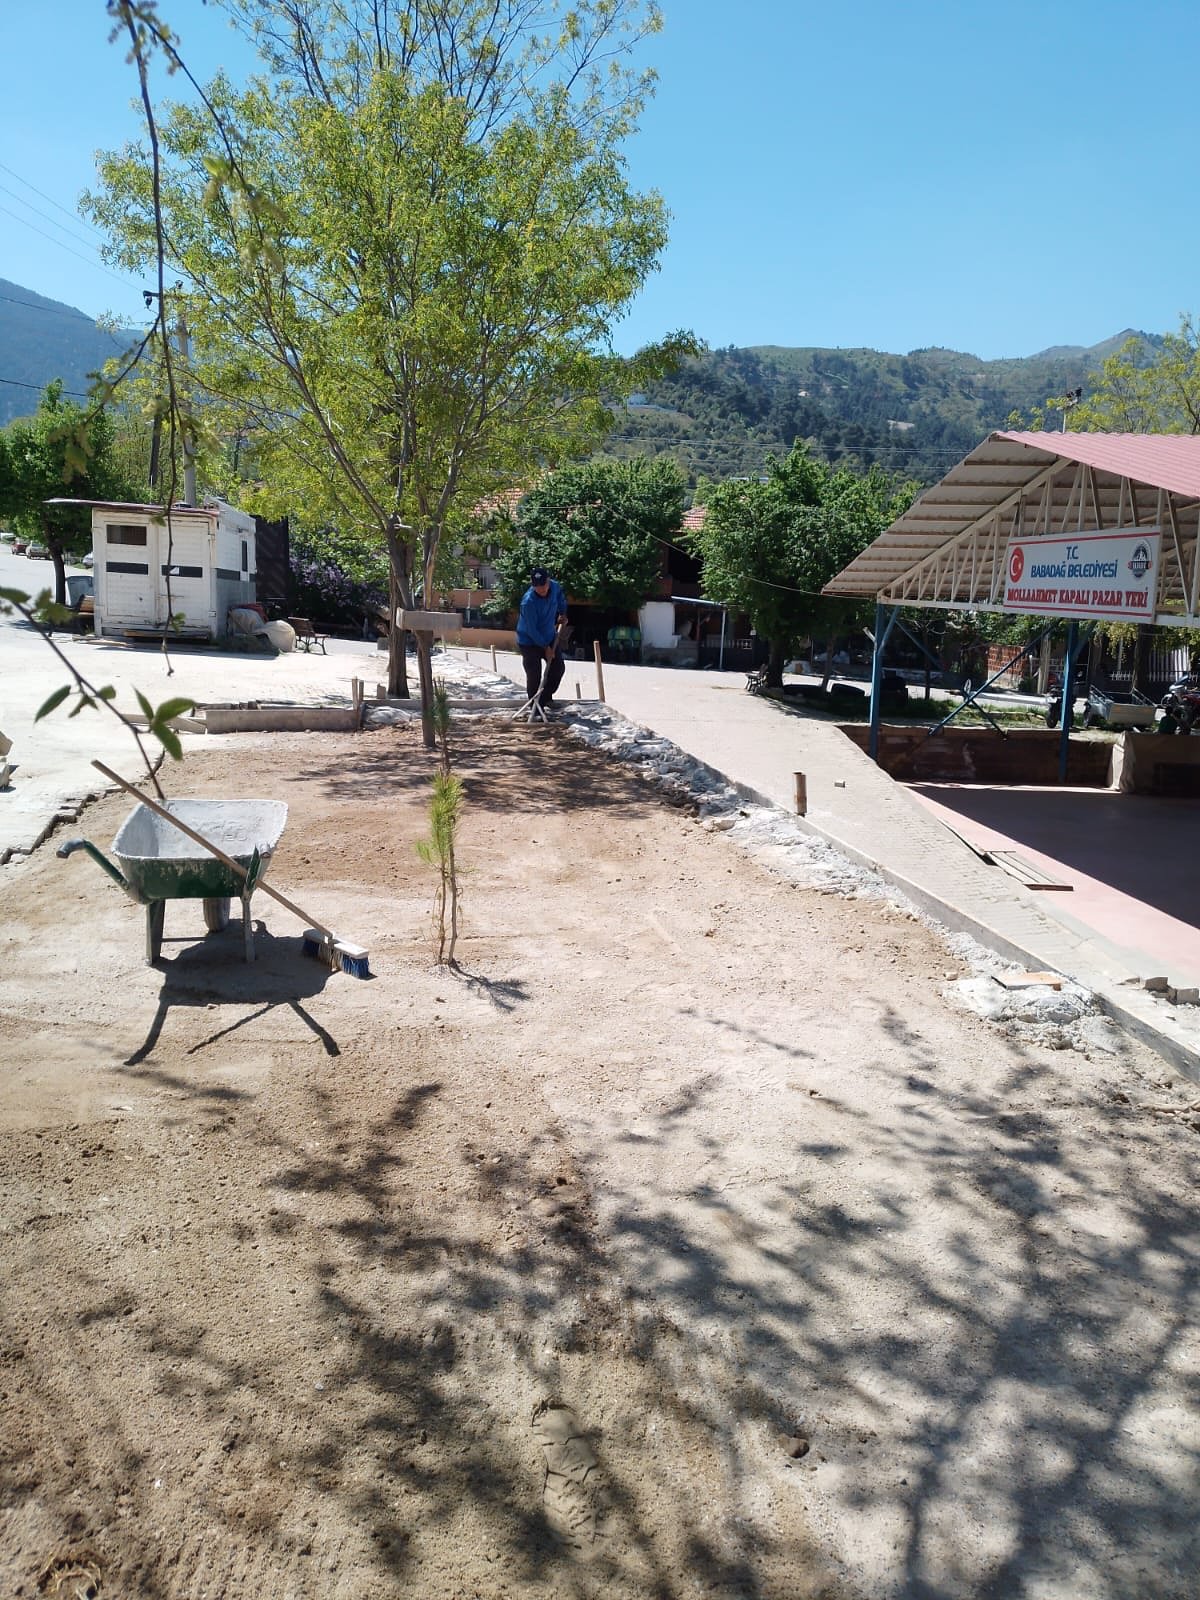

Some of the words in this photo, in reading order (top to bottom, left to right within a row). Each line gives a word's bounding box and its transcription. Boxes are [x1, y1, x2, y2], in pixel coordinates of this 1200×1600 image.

[1031, 561, 1066, 578] BABADAĞ
[1067, 559, 1118, 578] BELEDİYESİ
[1007, 588, 1058, 603] MOLLAAHMET
[1058, 590, 1090, 605] KAPALI
[1091, 590, 1122, 607] PAZAR
[1125, 586, 1148, 608] YERİ
